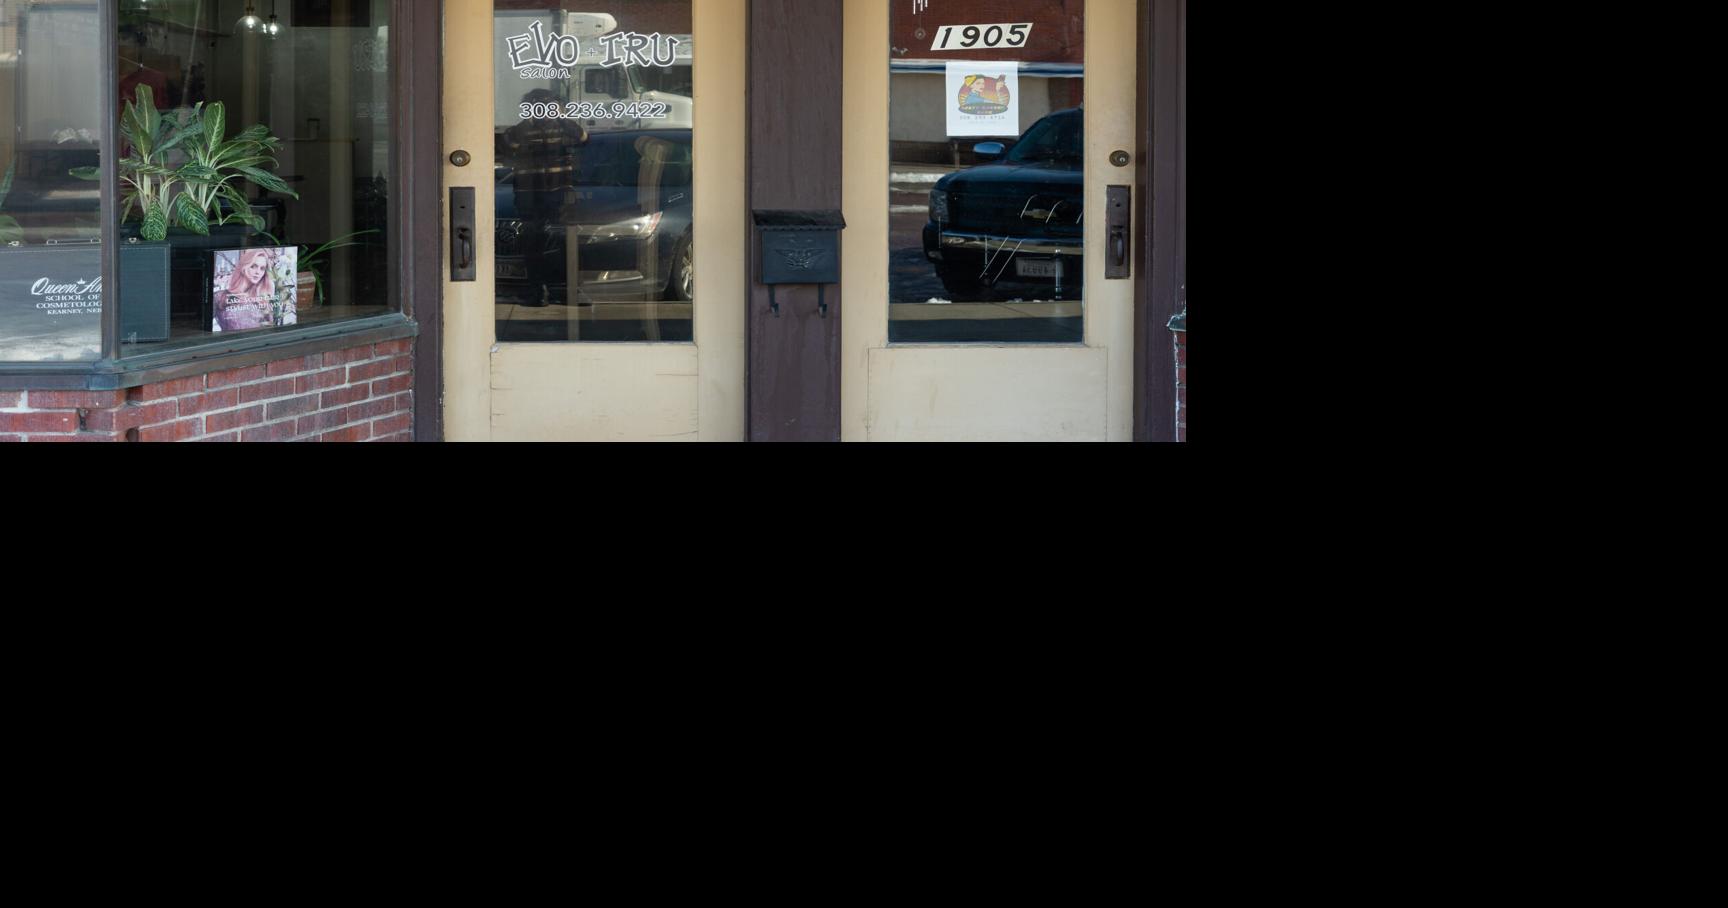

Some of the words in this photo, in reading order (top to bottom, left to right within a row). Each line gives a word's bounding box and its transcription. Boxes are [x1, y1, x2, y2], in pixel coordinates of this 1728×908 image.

[506, 20, 580, 69] EVO
[940, 24, 1028, 49] 1905
[520, 67, 571, 79] salon
[520, 102, 666, 119] 308.236.9422
[31, 277, 78, 295] Queen
[76, 275, 103, 294] An
[36, 301, 103, 309] COSMETOLOG
[45, 294, 84, 302] SCHOOL
